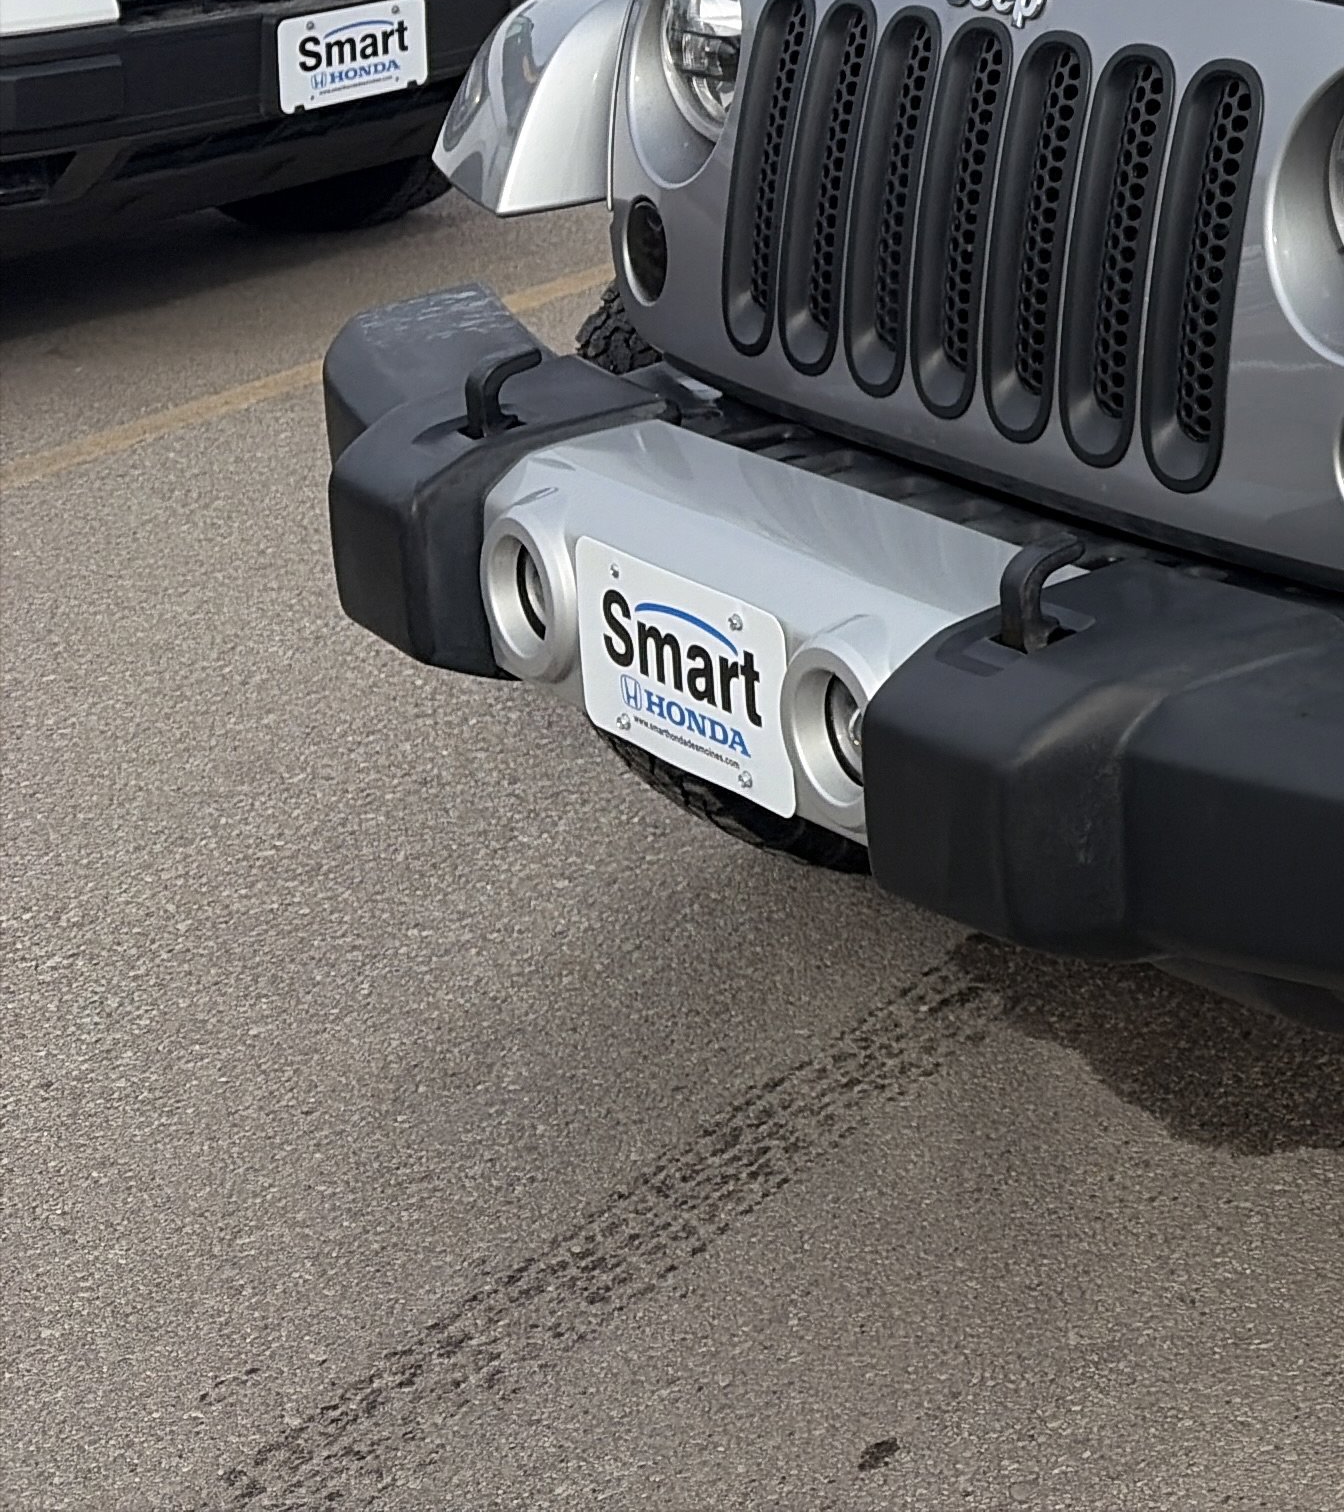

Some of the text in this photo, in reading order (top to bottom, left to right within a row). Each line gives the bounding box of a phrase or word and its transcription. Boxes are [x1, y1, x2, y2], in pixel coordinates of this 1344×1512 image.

[299, 19, 409, 72] Smart
[330, 59, 400, 85] HONDA
[602, 589, 762, 728] Smart
[644, 689, 751, 758] HONDA
